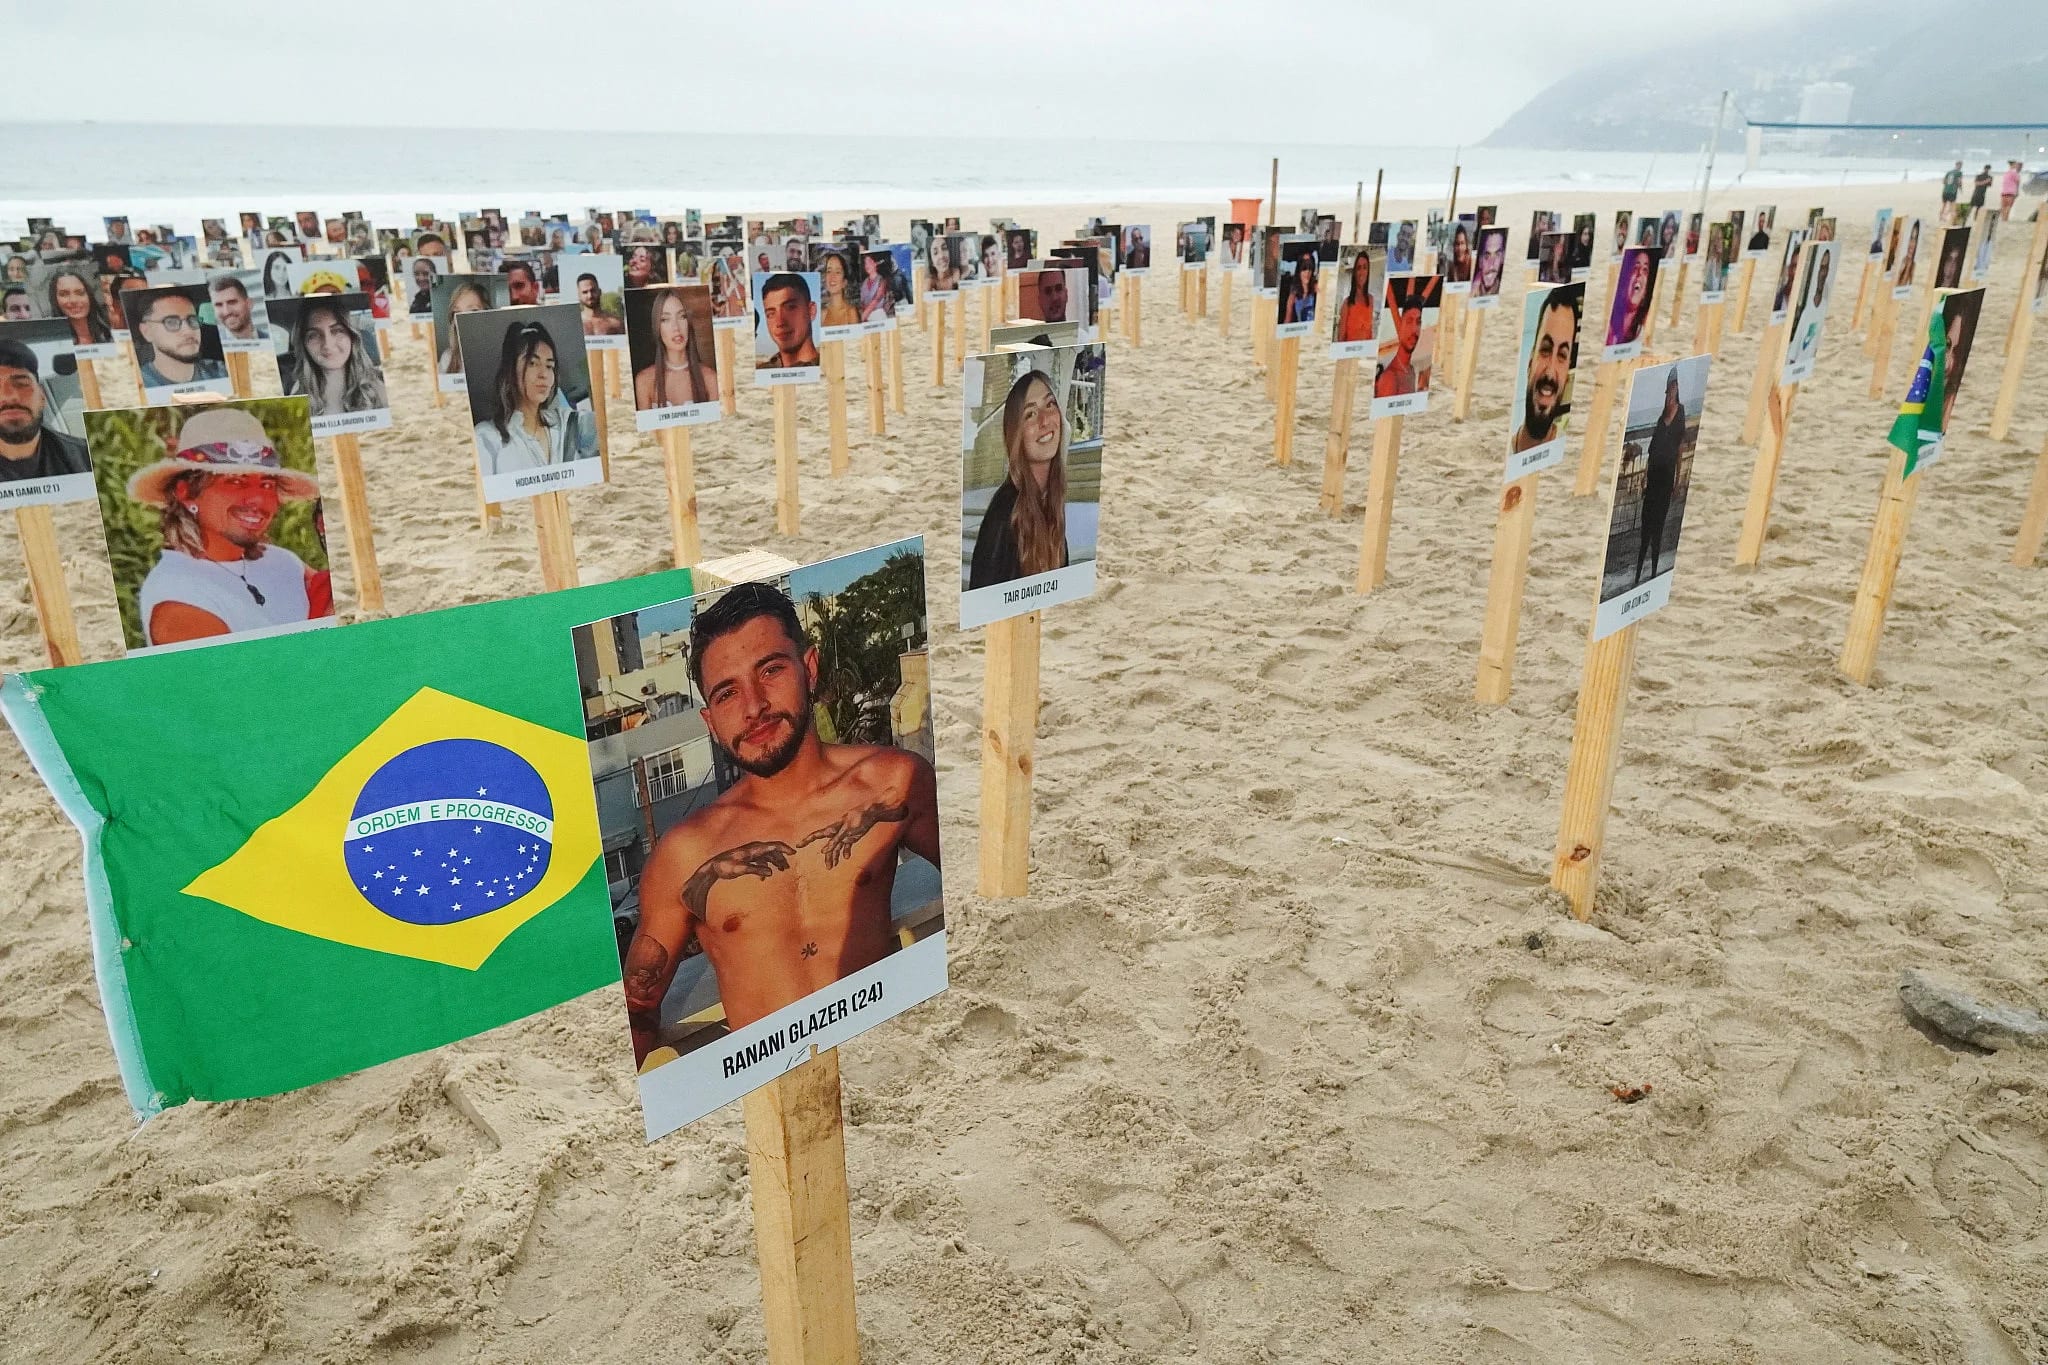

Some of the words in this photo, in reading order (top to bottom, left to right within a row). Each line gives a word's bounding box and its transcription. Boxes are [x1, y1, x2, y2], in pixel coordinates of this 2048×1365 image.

[15, 486, 42, 497] DAMRI
[43, 483, 60, 494] (21)
[515, 473, 541, 488] HODAYA
[541, 471, 560, 483] DAVID
[561, 469, 575, 479] (27)
[1003, 589, 1020, 605] TAIR
[1021, 583, 1042, 600] DAVID
[1043, 580, 1058, 594] (24)
[357, 806, 421, 835] ORDEM
[430, 804, 441, 819] E
[446, 803, 548, 834] PROGRESSO
[722, 1029, 786, 1079] RANANI
[788, 998, 848, 1044] GLAZER
[851, 981, 883, 1012] (24)
